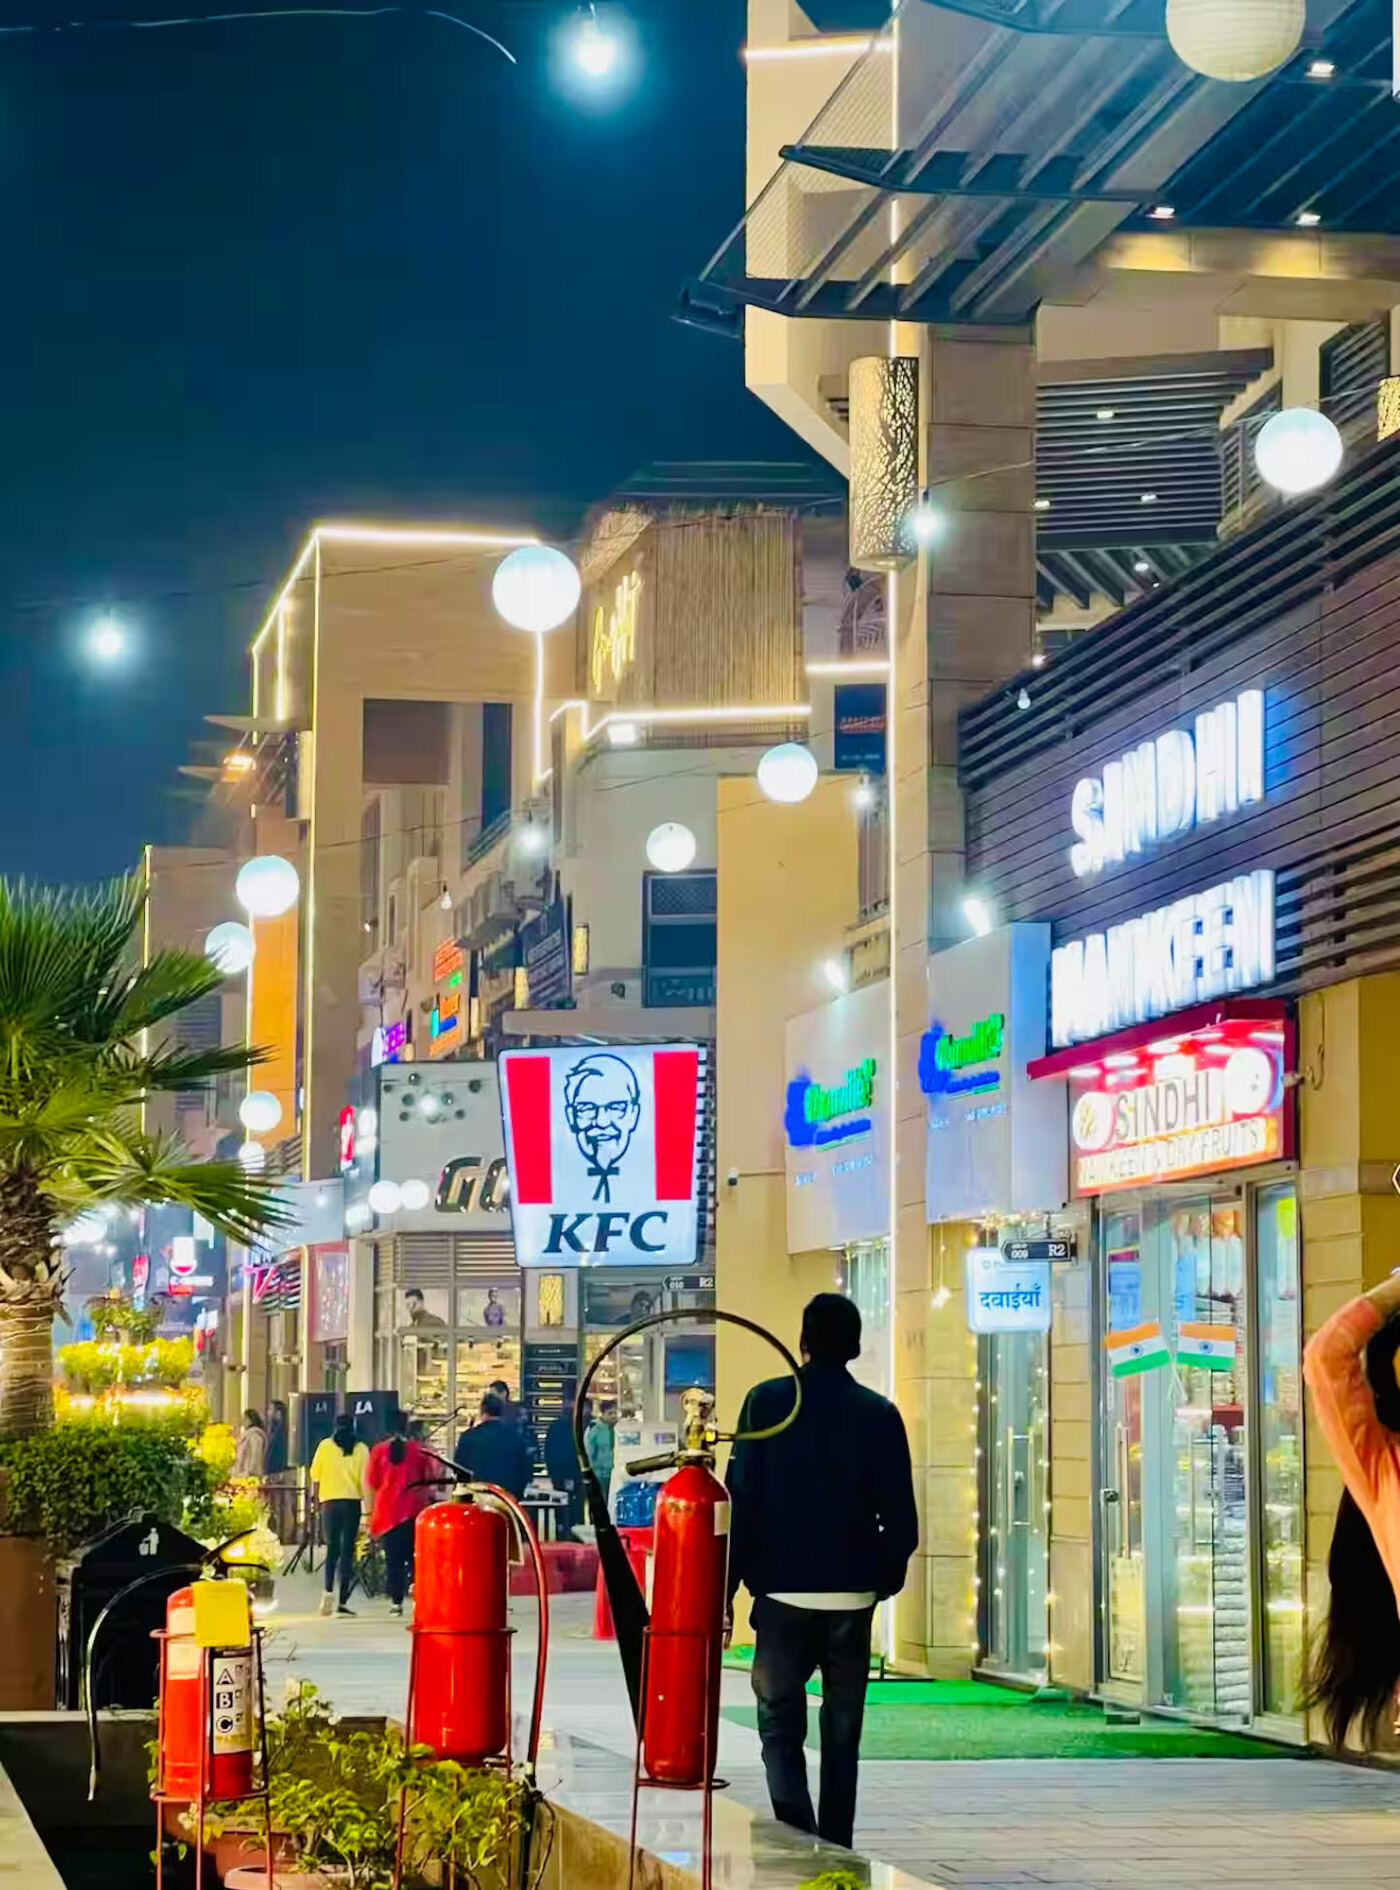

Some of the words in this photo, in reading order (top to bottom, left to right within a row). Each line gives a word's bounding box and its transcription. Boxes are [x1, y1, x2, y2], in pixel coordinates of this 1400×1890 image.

[1071, 689, 1265, 877] SINDHI
[1052, 869, 1276, 1047] NAMKEEN
[1114, 1070, 1210, 1140] SINDHI
[543, 1211, 668, 1253] KFC
[1048, 1244, 1066, 1257] R2
[699, 1277, 714, 1288] R2
[979, 1283, 1041, 1310] दवाईयाँ
[355, 1400, 373, 1415] LA
[218, 1669, 232, 1684] A
[219, 1693, 231, 1708] B
[216, 1716, 233, 1733] C
